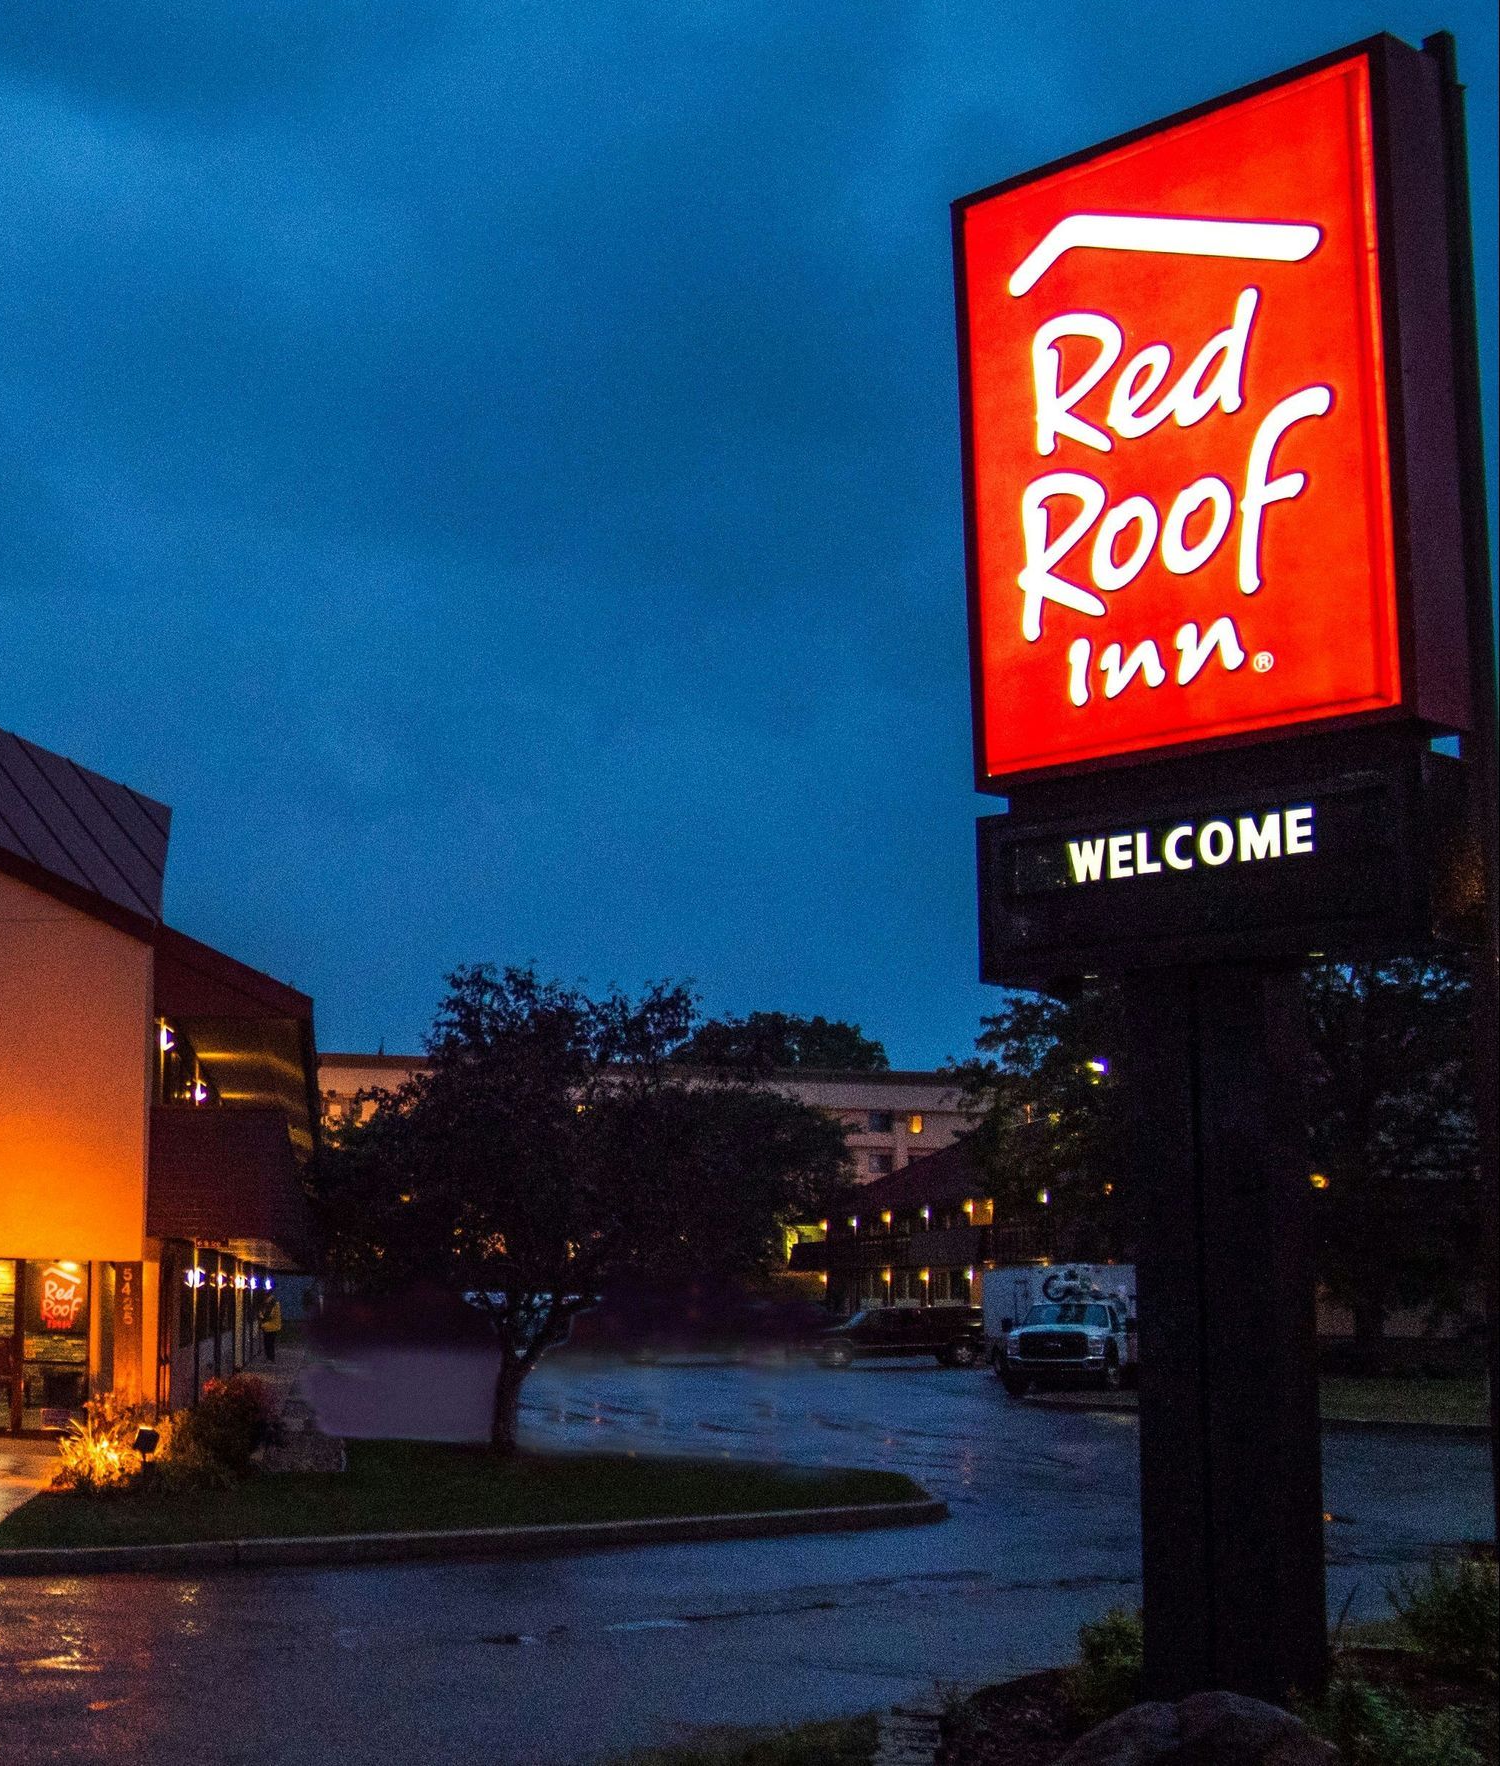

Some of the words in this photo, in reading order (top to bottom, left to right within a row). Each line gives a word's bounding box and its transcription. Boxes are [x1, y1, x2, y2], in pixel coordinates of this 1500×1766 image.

[1032, 287, 1259, 456] Red
[1017, 386, 1331, 642] Roof
[1068, 617, 1246, 707] Inn
[1067, 807, 1314, 884] WELCOME
[41, 1297, 83, 1320] Roof
[44, 1280, 76, 1301] Red
